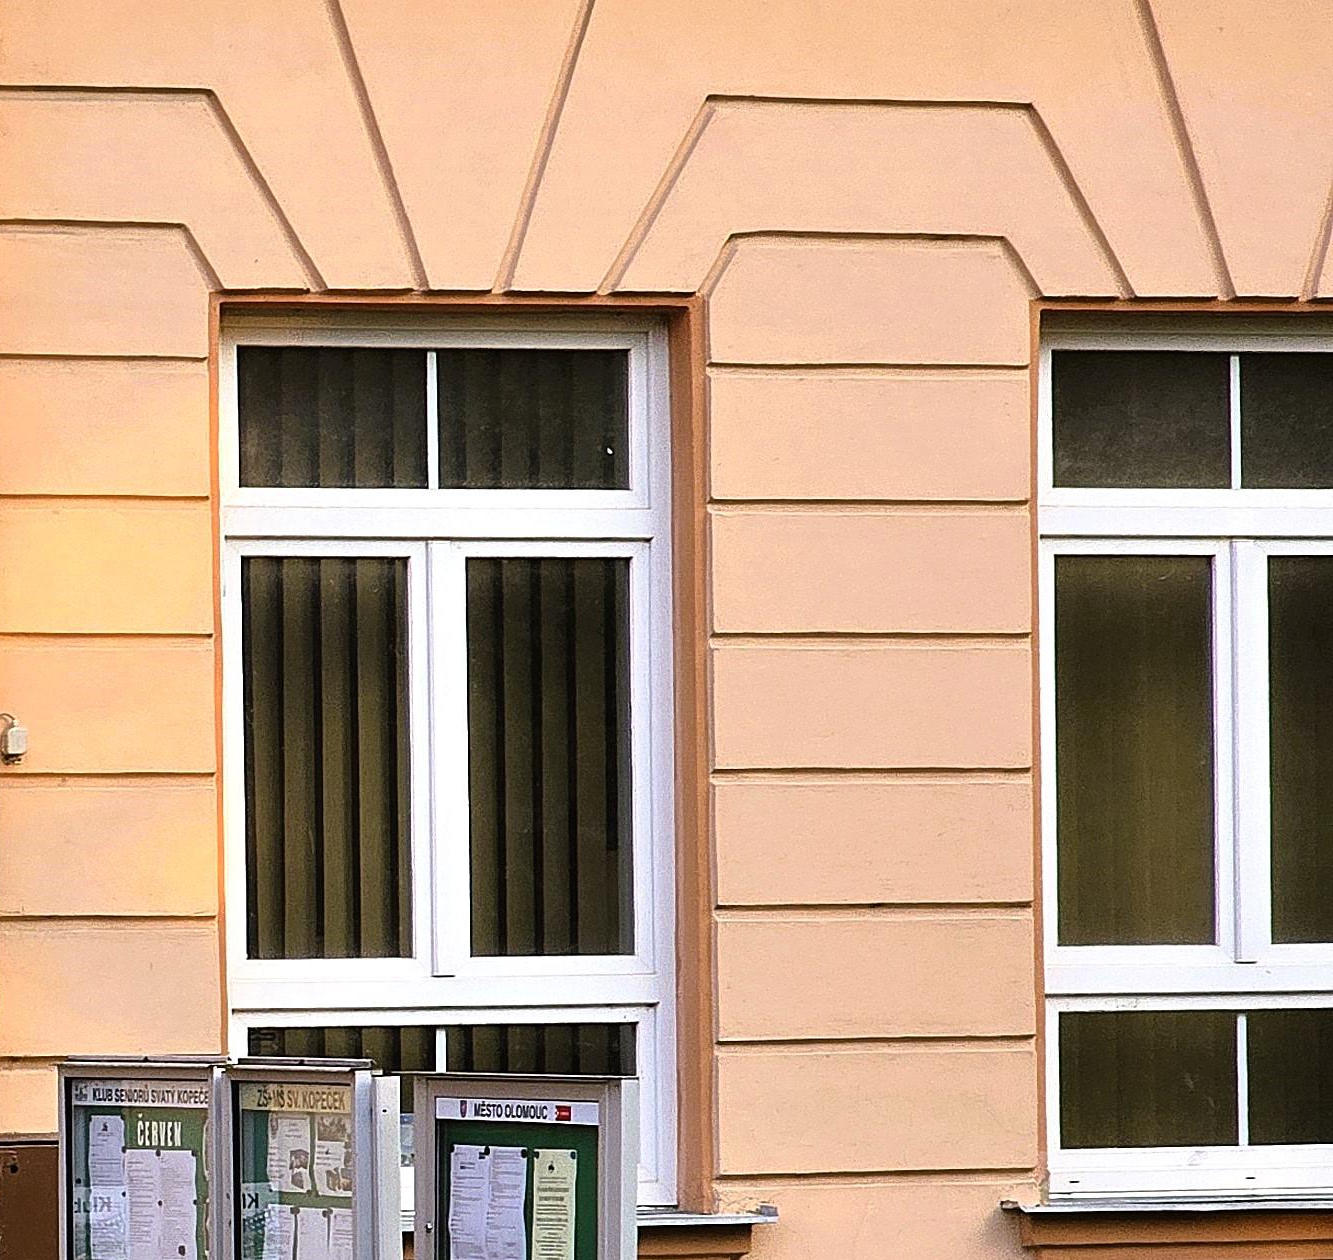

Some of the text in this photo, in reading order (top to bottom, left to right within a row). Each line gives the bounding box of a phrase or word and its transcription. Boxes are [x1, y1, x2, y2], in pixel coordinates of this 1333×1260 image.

[92, 1087, 114, 1102] KLUB
[302, 1086, 346, 1111] KOPEČEK
[473, 1100, 548, 1121] MĚSTO OLOMOUC
[137, 1112, 182, 1147] ČERVEN
